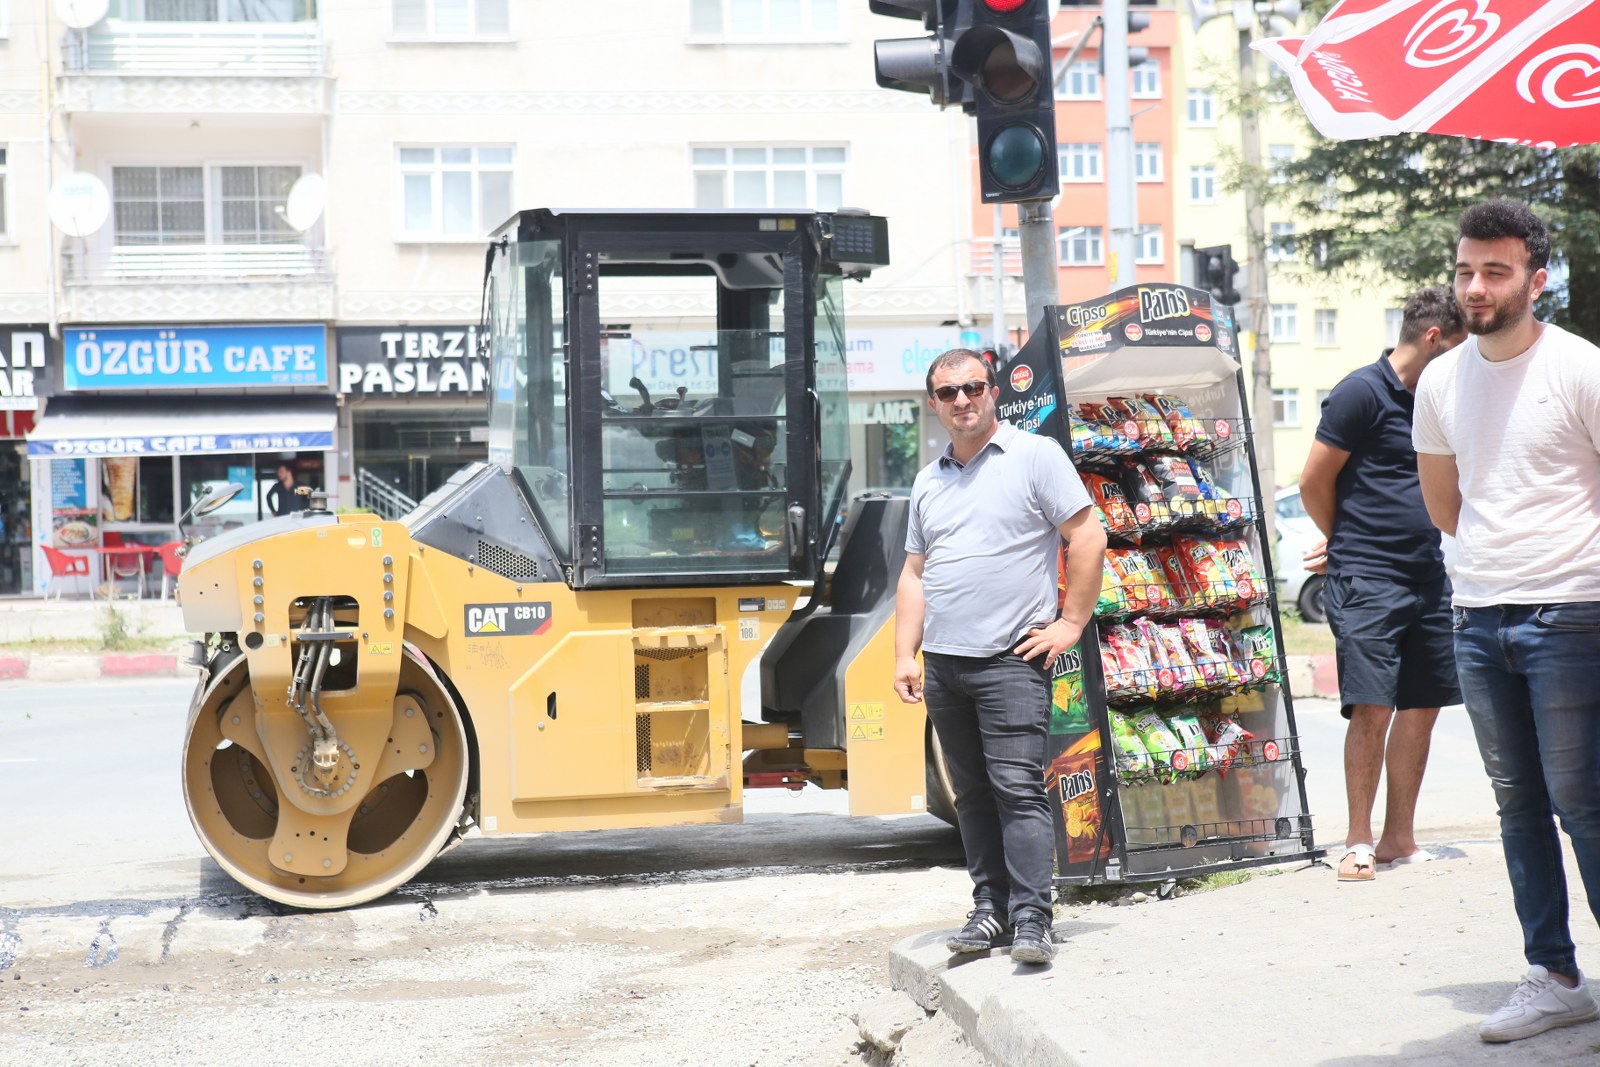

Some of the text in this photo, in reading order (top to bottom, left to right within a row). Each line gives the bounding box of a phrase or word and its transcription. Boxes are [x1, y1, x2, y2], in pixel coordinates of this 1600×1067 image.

[75, 331, 317, 376] ÖZGÜR CAFE
[999, 392, 1054, 419] Türkiye'nin
[151, 435, 218, 451] CAFE
[468, 606, 546, 631] CAT CB10
